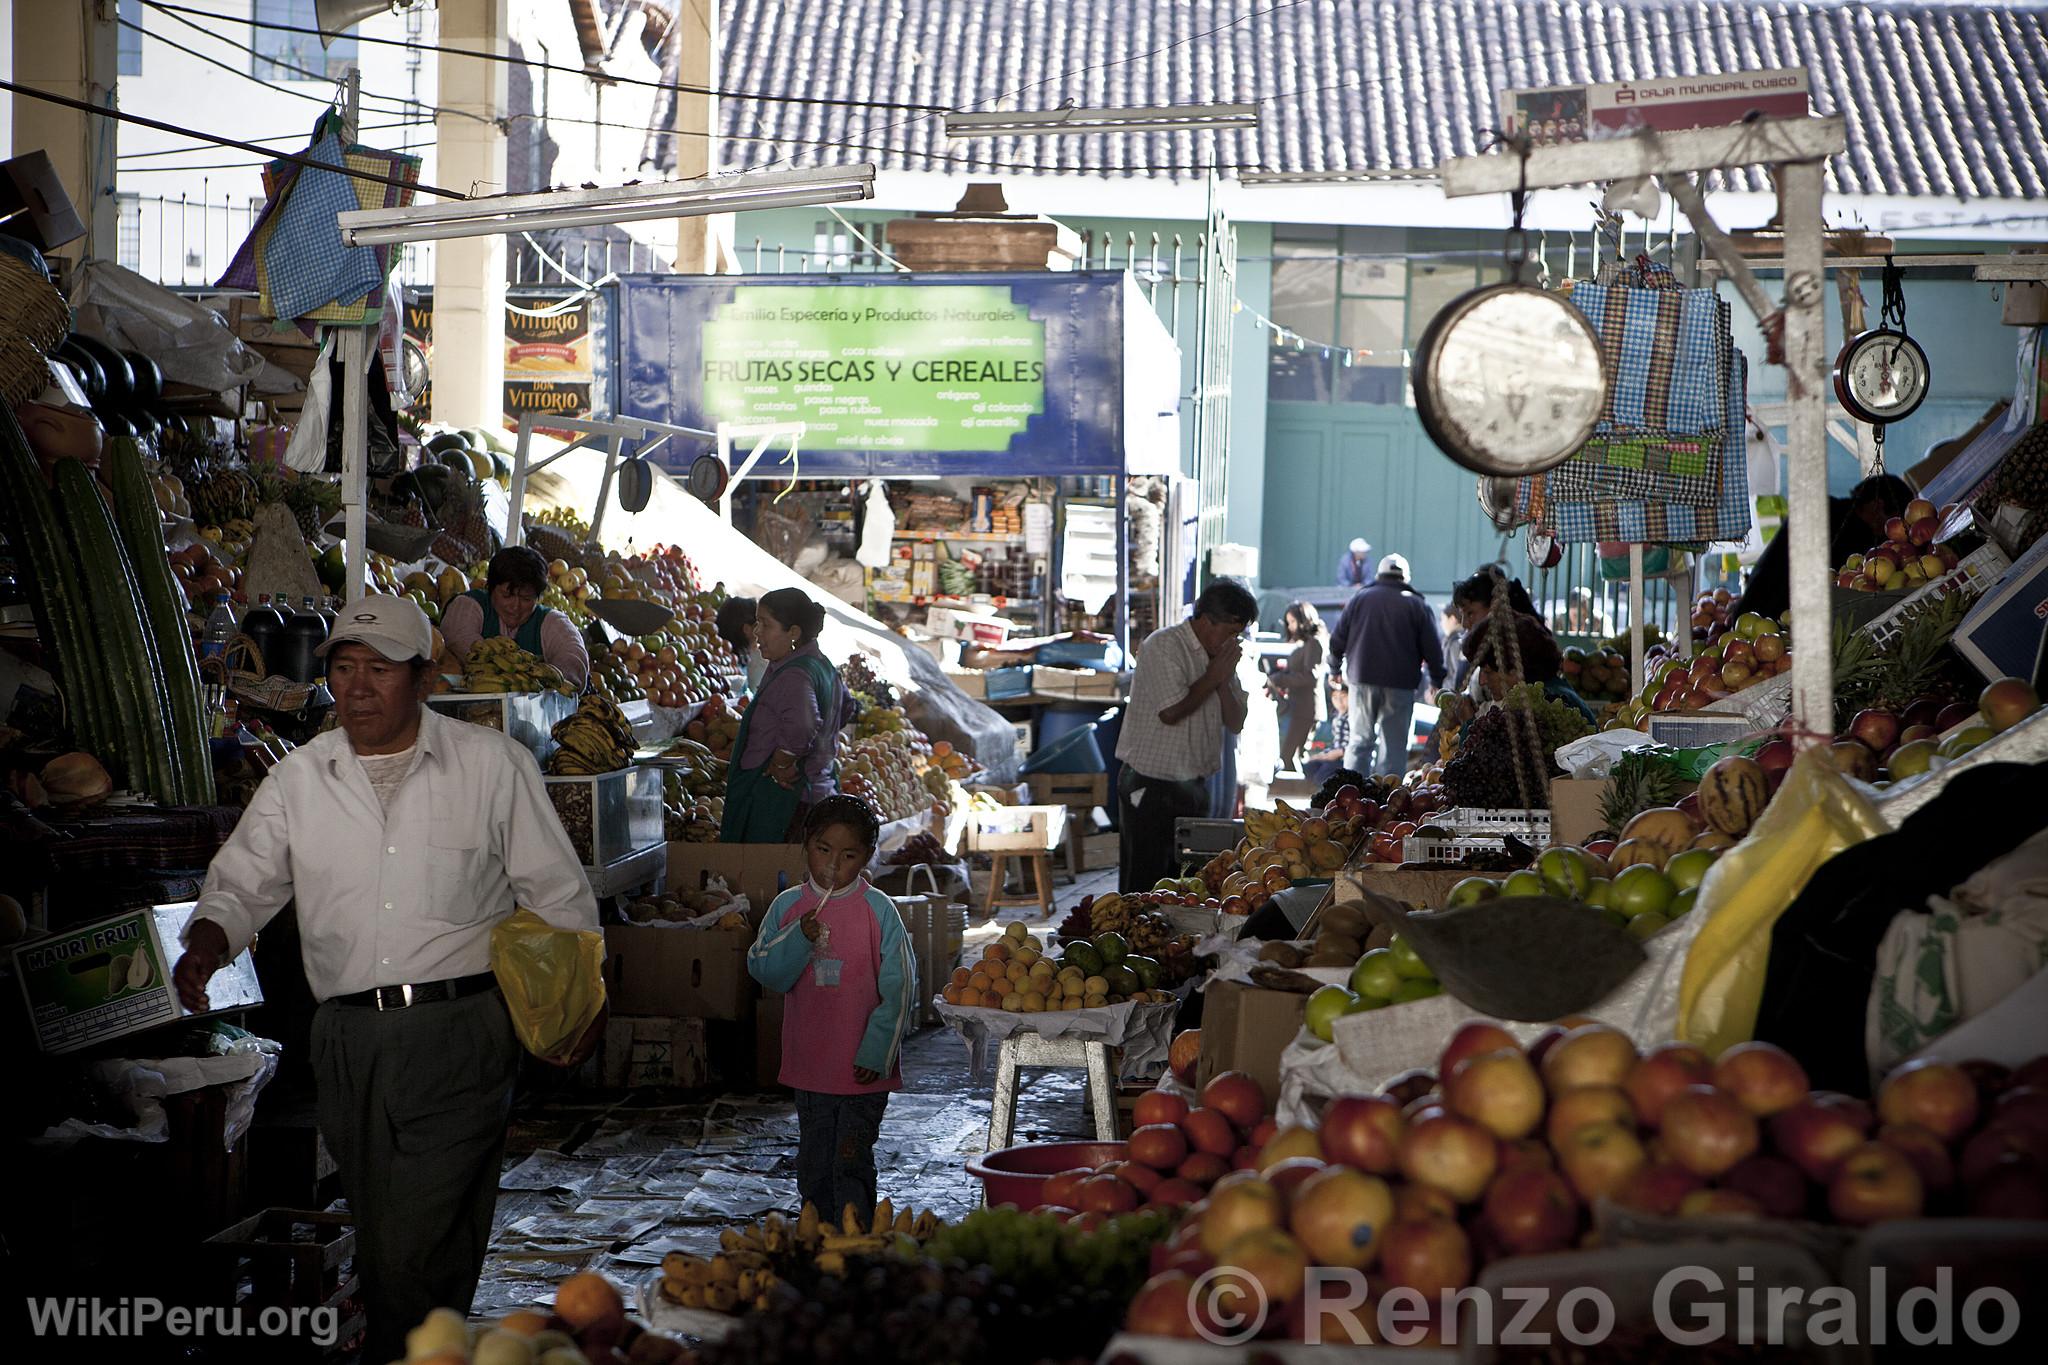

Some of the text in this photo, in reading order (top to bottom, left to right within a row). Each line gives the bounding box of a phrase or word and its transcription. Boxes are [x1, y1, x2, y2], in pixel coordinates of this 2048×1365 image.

[1640, 76, 1798, 98] CAJA MUNICIPAL CUSCO
[731, 306, 1017, 323] Emilia Especería y Productos Naturales
[704, 359, 1046, 383] FRUTAS SECAS Y CEREALES
[532, 382, 554, 391] DON
[508, 388, 579, 412] VITTORIO
[27, 920, 140, 969] MAURI FRUT
